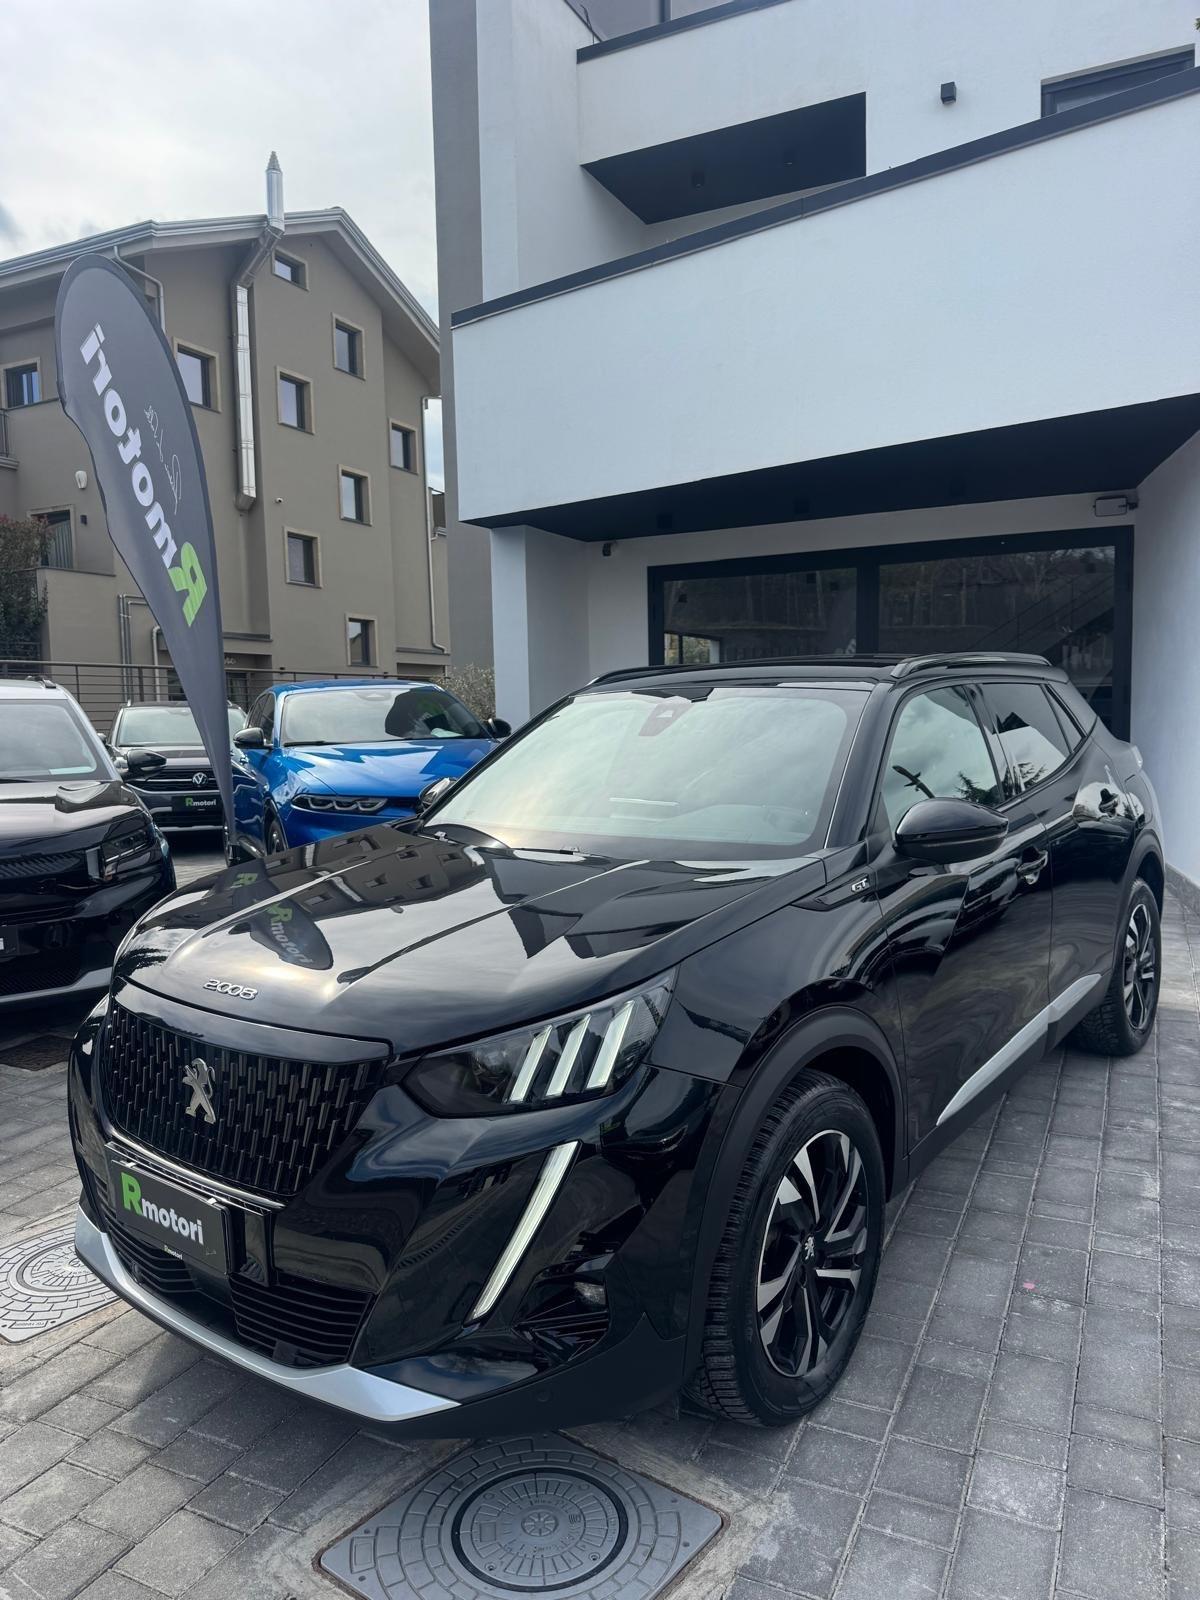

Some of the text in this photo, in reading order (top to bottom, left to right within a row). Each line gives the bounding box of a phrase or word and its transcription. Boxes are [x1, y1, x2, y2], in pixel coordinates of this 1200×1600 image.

[185, 797, 217, 807] Rmotori
[851, 878, 868, 892] GT
[203, 978, 258, 1000] 2008
[120, 1171, 205, 1245] Rmotori
